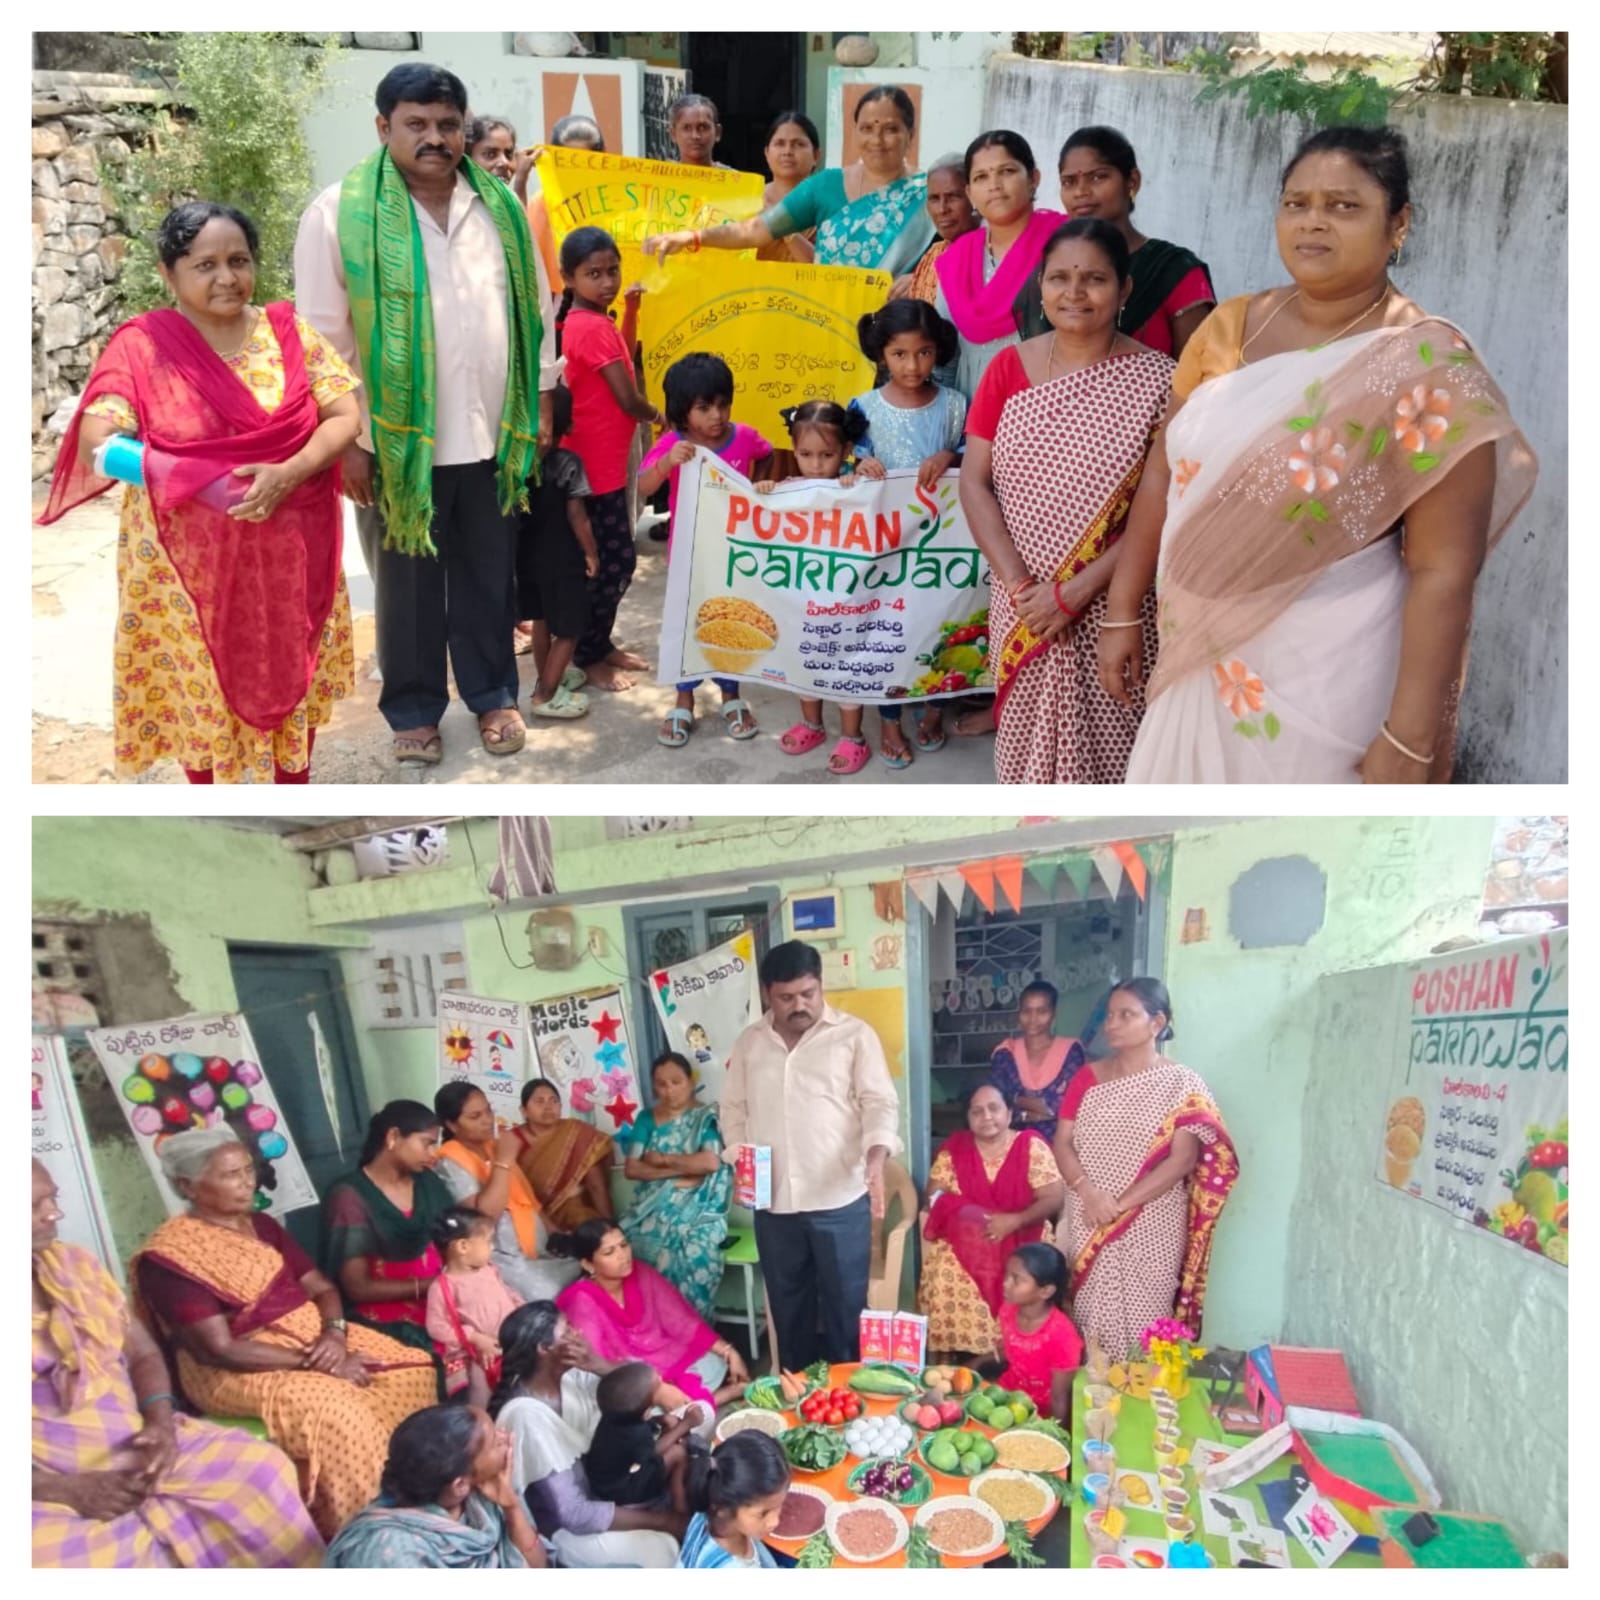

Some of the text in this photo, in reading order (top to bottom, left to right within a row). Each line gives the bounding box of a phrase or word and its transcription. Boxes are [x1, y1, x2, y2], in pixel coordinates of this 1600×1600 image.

[725, 494, 902, 553] POSHAN
[1412, 954, 1519, 1016] POSHAN
[529, 996, 589, 1020] Magic
[104, 1030, 156, 1056] పుట్టిన
[159, 1024, 195, 1044] రోజు
[531, 1013, 590, 1037] Words
